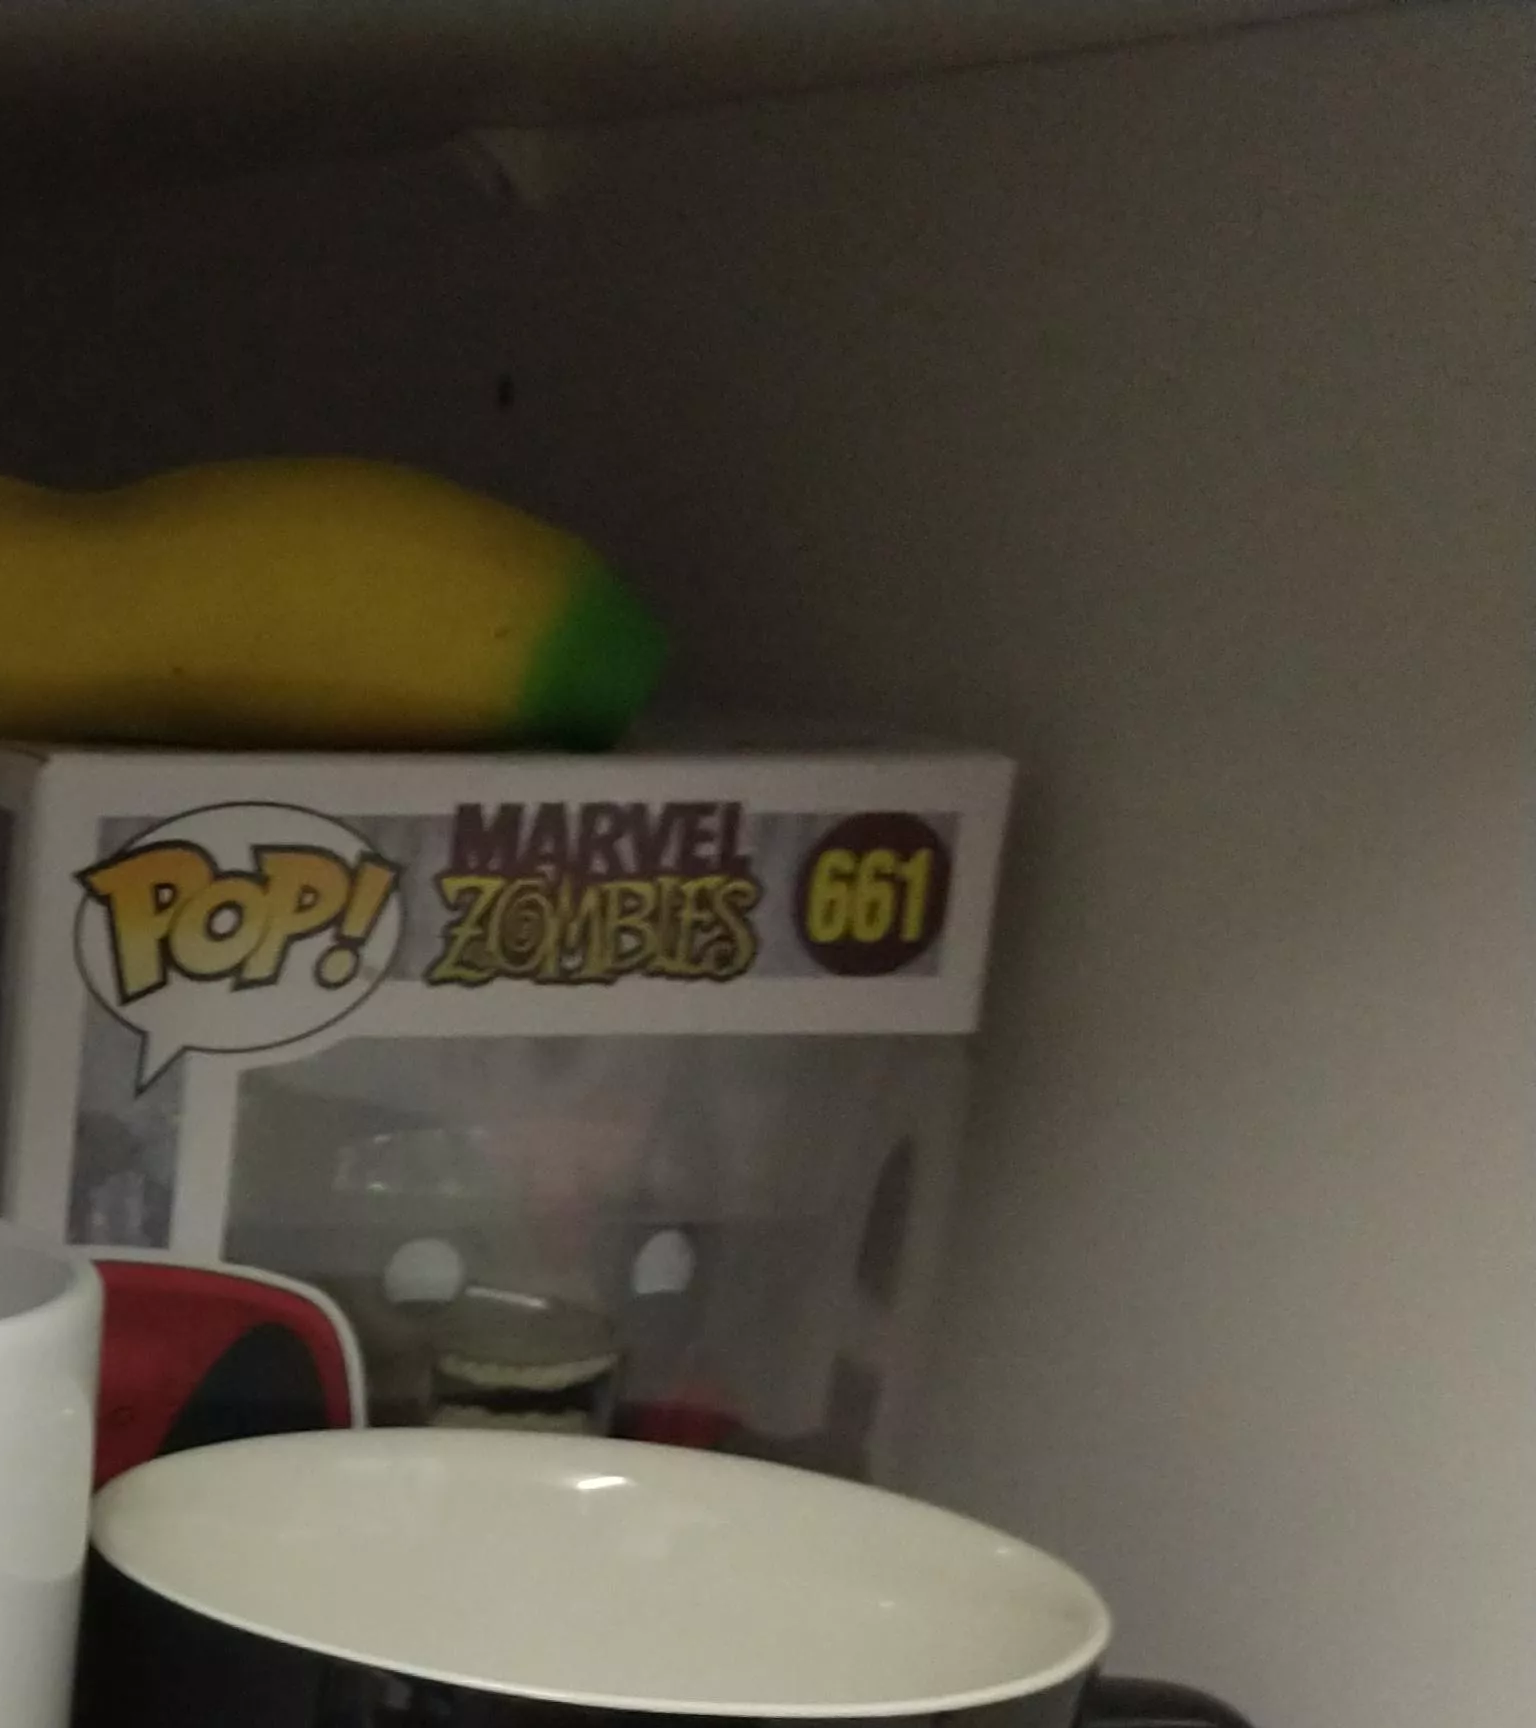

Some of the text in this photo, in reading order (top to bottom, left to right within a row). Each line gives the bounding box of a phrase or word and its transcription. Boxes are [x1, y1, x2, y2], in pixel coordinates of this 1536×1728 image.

[448, 801, 751, 882] MARVEL
[74, 840, 403, 1005] POP!
[424, 870, 760, 986] ZOMBIES
[806, 849, 928, 945] 661
